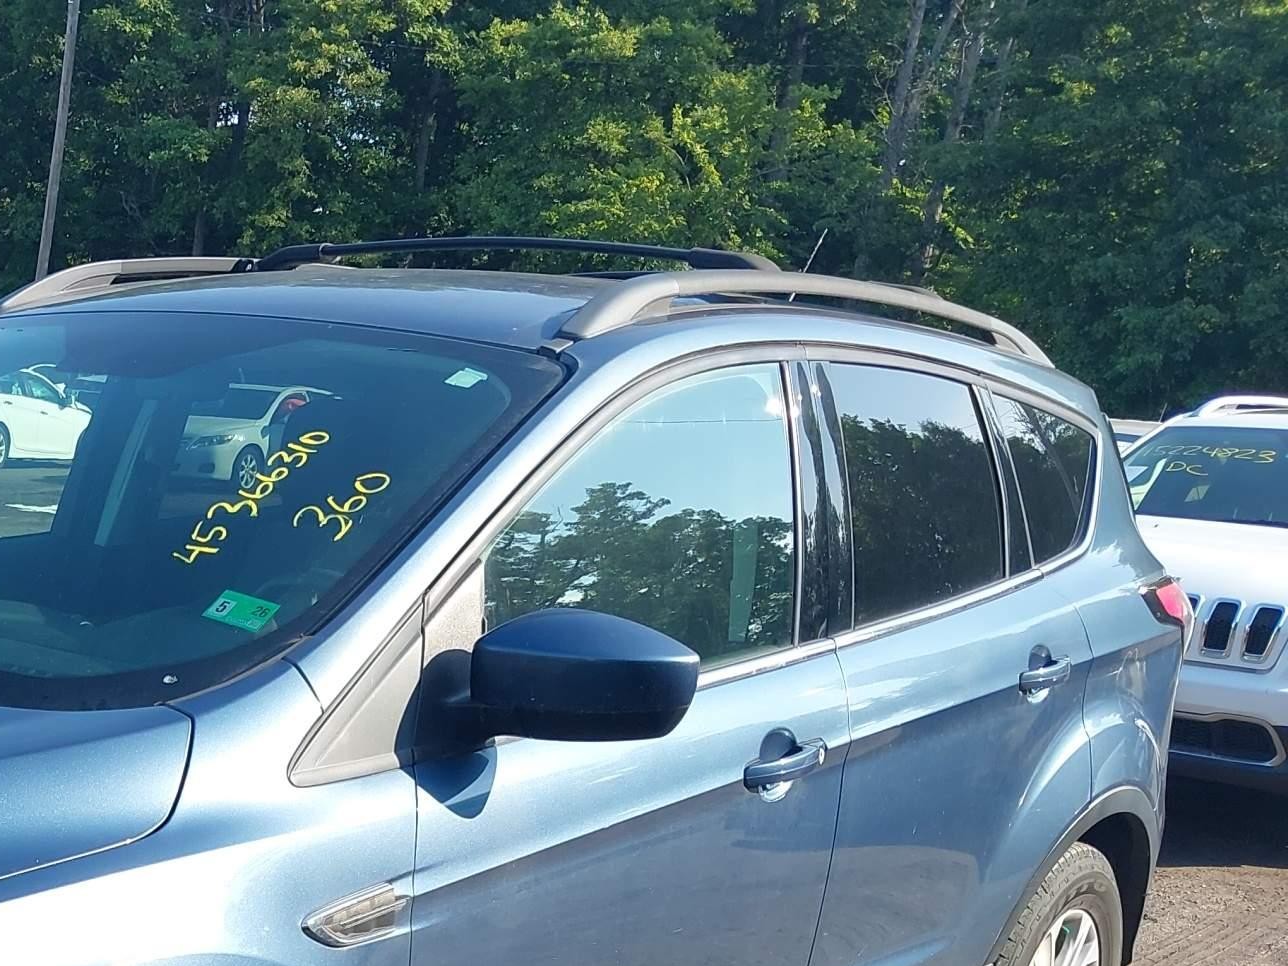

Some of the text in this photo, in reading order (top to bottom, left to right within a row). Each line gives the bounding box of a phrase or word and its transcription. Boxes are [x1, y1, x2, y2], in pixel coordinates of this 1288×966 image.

[1166, 461, 1209, 477] DC
[172, 430, 331, 567] 45366310
[293, 472, 391, 542] 360
[215, 600, 272, 618] 5 26
